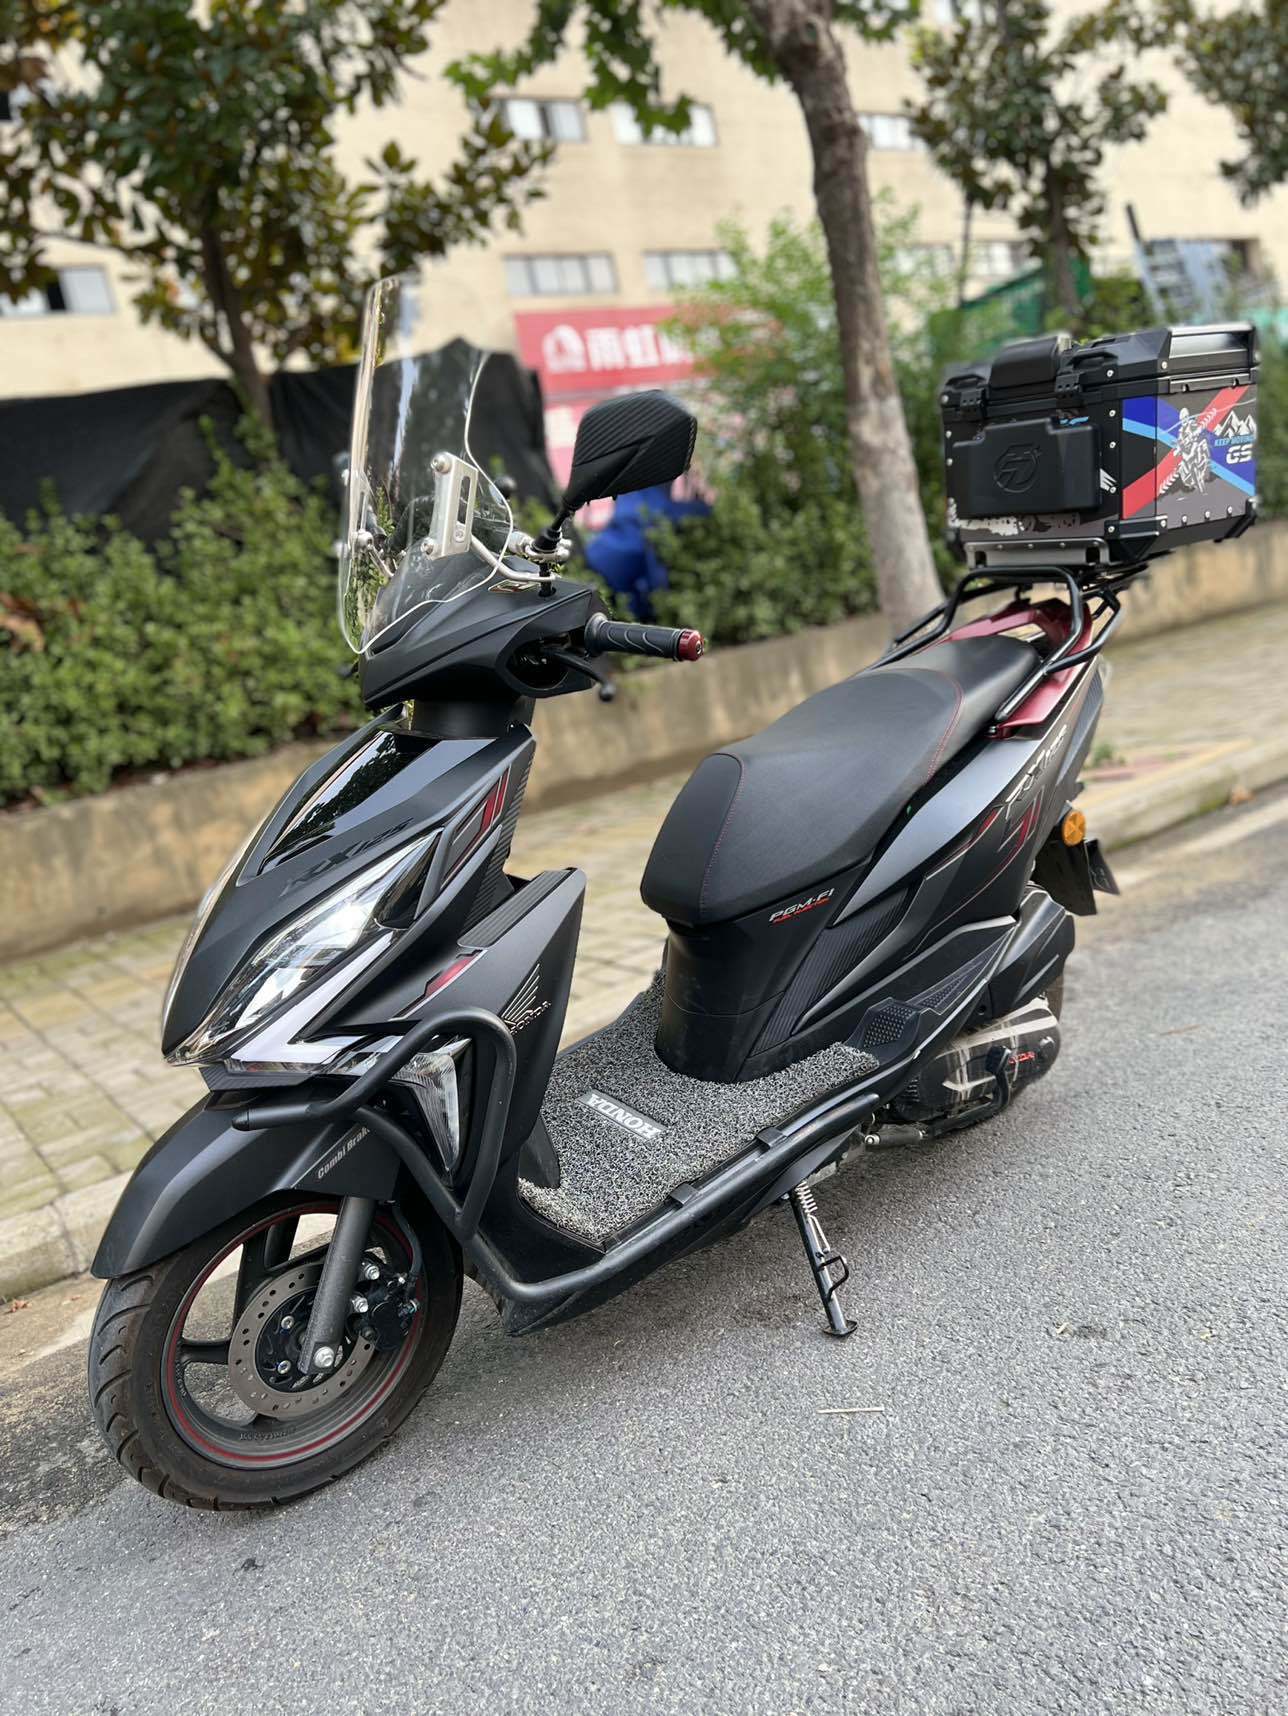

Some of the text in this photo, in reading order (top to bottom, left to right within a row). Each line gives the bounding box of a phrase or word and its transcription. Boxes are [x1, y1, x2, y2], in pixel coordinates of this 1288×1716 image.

[1226, 443, 1254, 464] GS
[587, 1093, 662, 1139] HONDA
[318, 1146, 346, 1179] Combi
